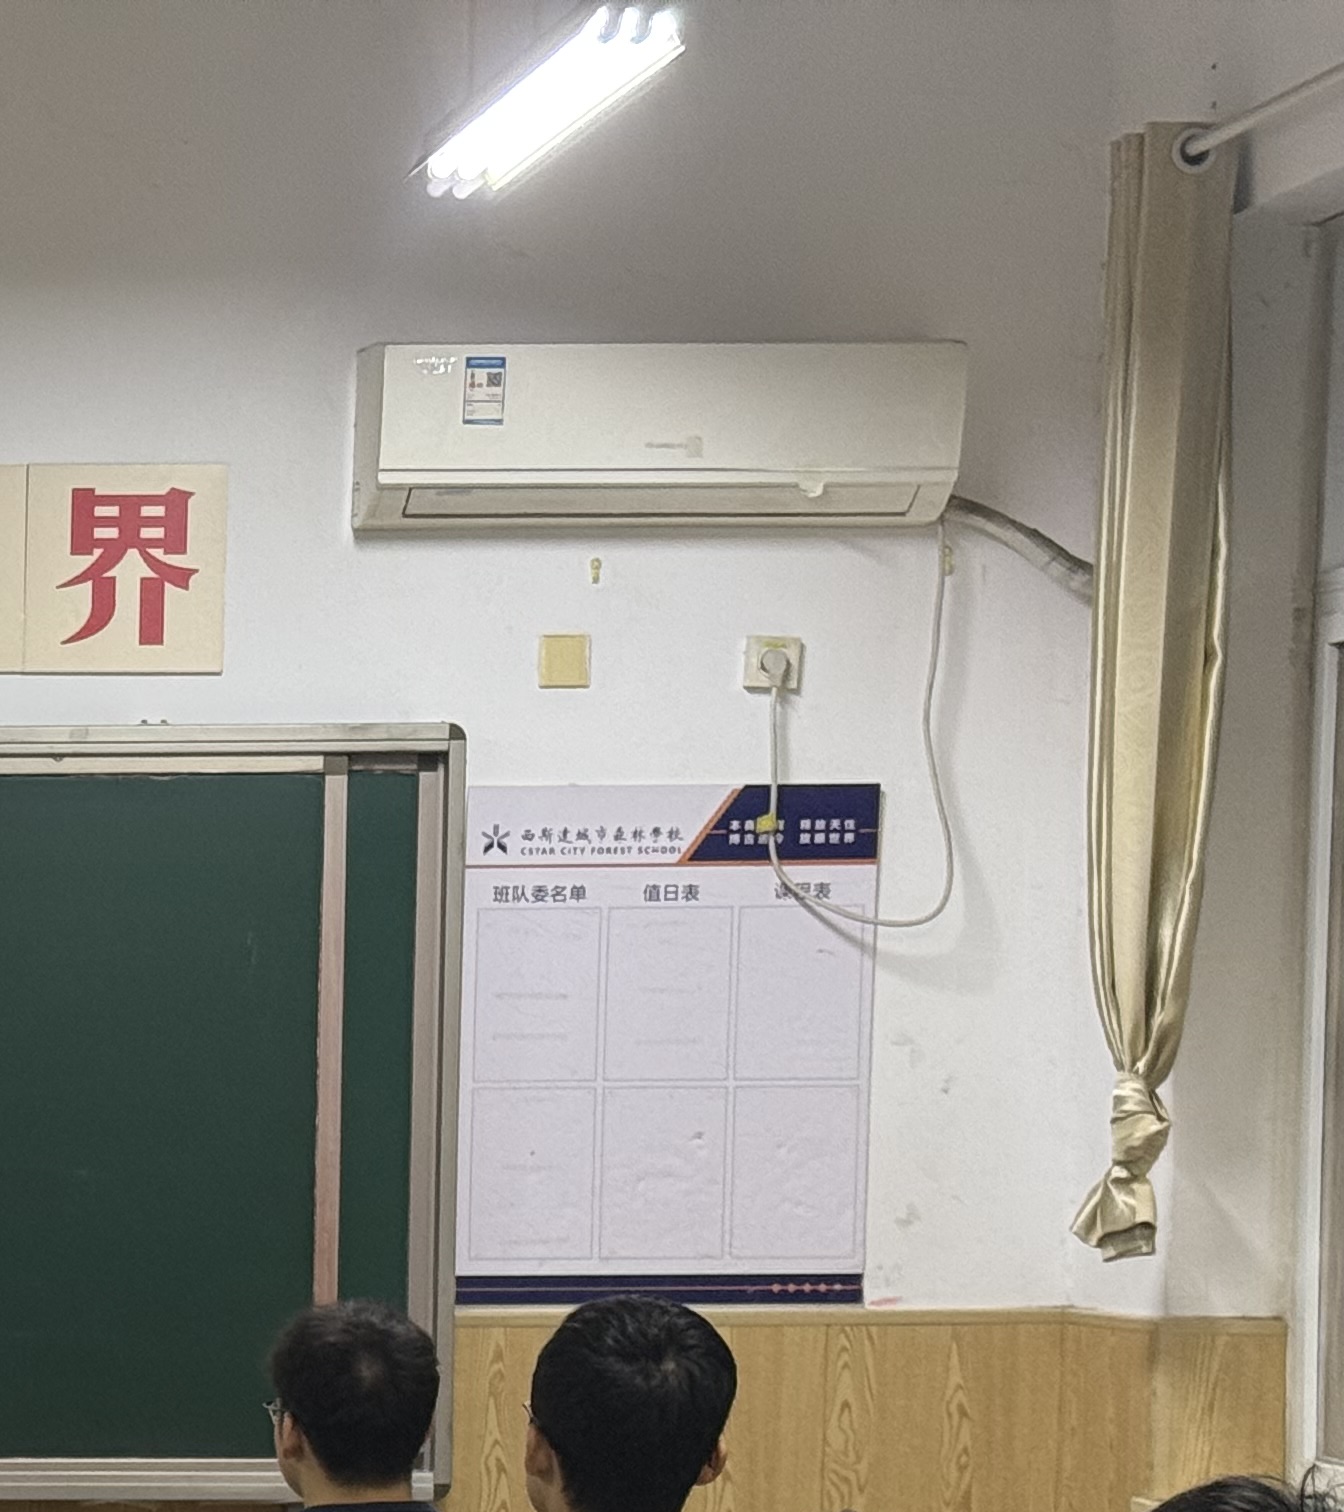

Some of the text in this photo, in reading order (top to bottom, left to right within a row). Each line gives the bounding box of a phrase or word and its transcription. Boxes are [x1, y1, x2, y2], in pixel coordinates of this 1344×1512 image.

[520, 844, 682, 856] CSTAR CITY FOREST SCHOOL
[492, 884, 587, 903] 班队委名单
[643, 884, 701, 903] 值日表
